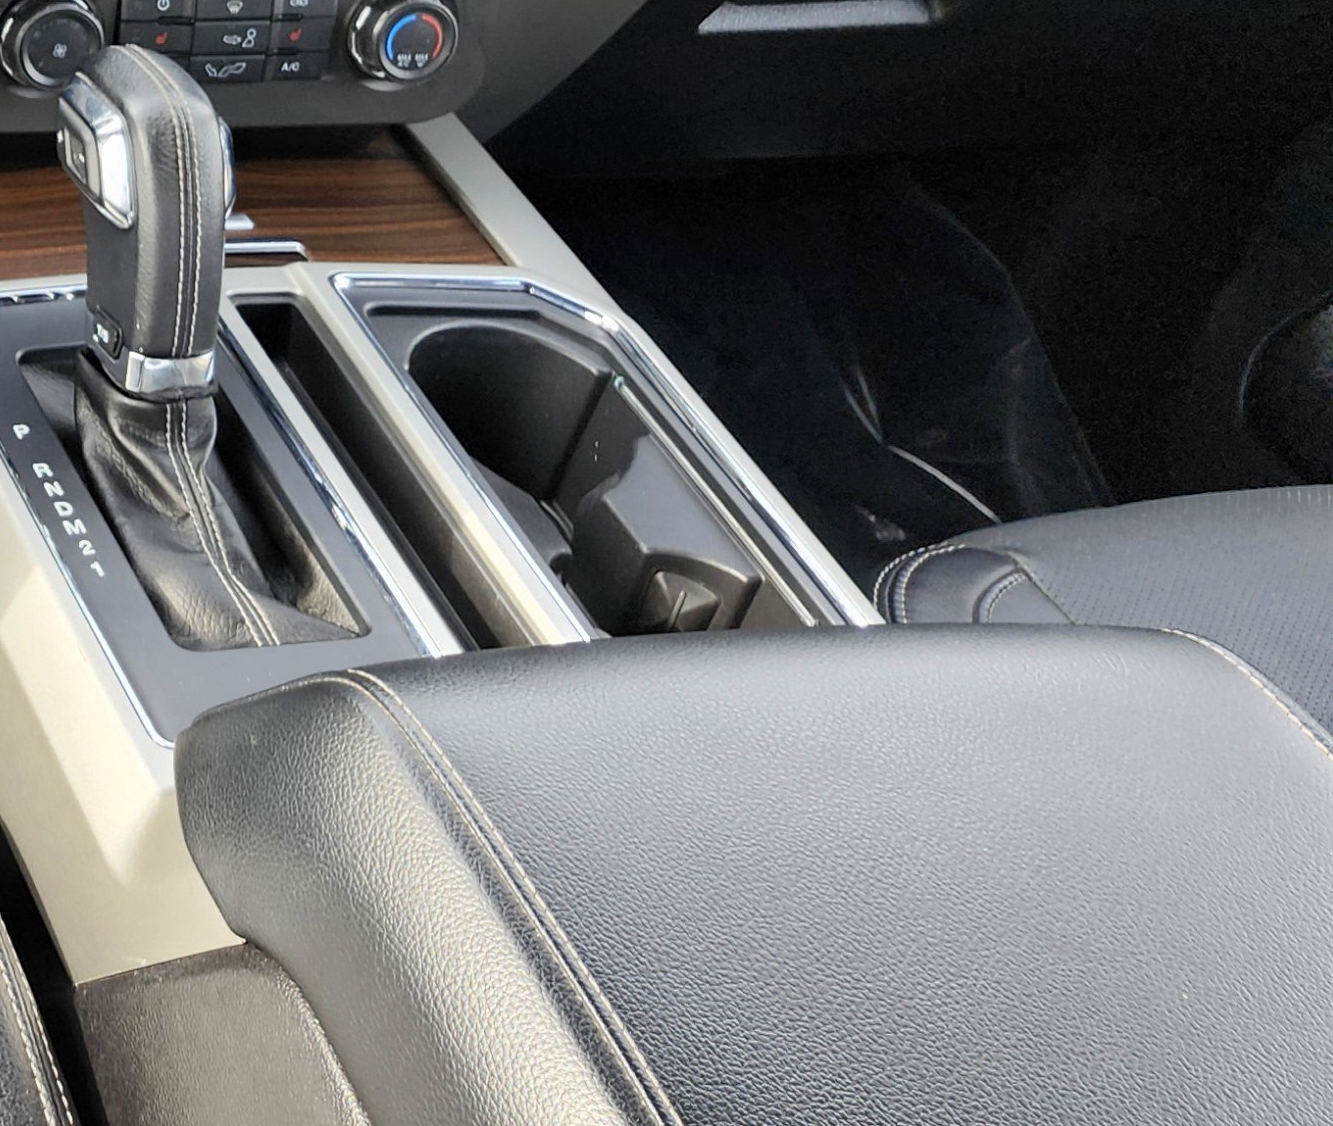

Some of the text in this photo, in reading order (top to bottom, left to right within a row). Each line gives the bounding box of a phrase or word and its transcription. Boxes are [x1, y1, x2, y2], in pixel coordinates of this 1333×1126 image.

[281, 61, 300, 72] A/C
[13, 424, 30, 440] P
[32, 462, 53, 477] R
[43, 481, 65, 498] N
[54, 501, 73, 517] D
[62, 519, 87, 535] M
[79, 539, 96, 556] 2
[90, 561, 105, 577] 1
